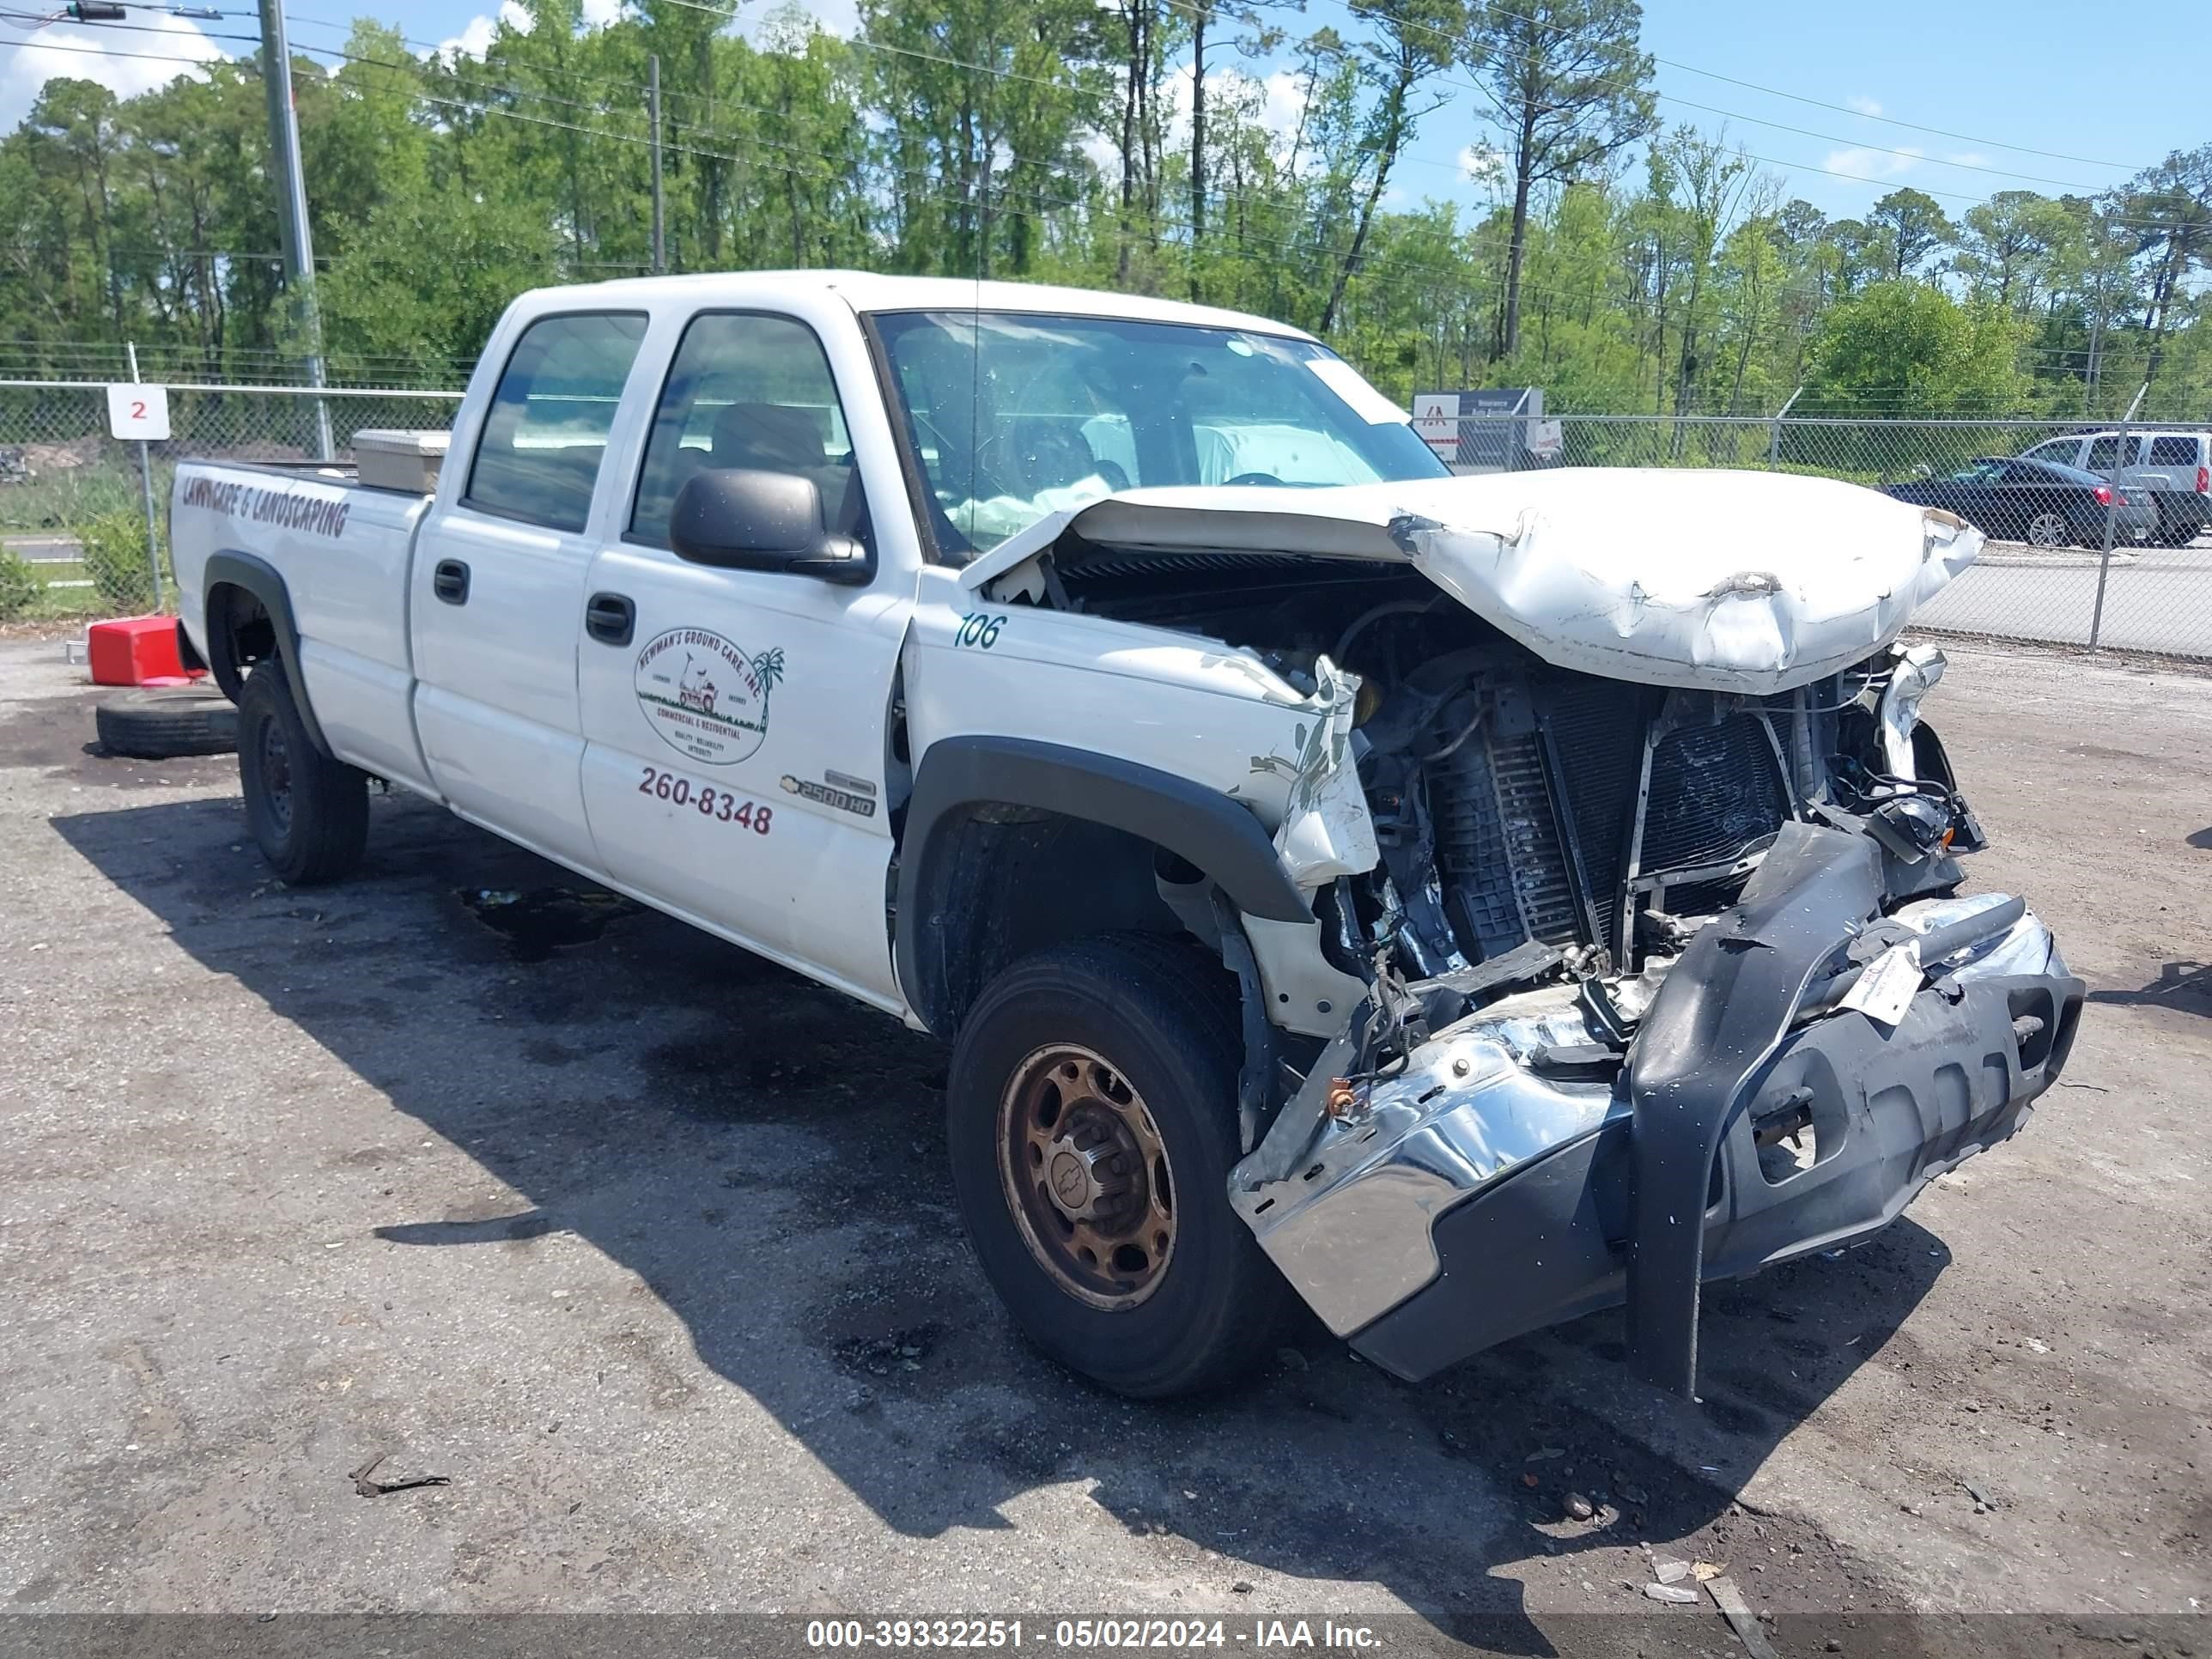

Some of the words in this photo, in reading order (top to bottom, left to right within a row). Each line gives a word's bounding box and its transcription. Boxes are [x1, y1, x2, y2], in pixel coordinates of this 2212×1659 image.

[131, 401, 148, 419] 2
[252, 489, 350, 538] LANDSCAPING
[954, 612, 1008, 650] 106
[684, 631, 721, 653] GROUND
[720, 644, 744, 677] CARE,
[744, 672, 762, 703] INC.
[657, 707, 695, 726] COMMERCIAL
[701, 721, 741, 740] RESIDENTIAL
[638, 767, 773, 836] 260-8348
[800, 781, 847, 808] 2500
[849, 796, 872, 815] HD
